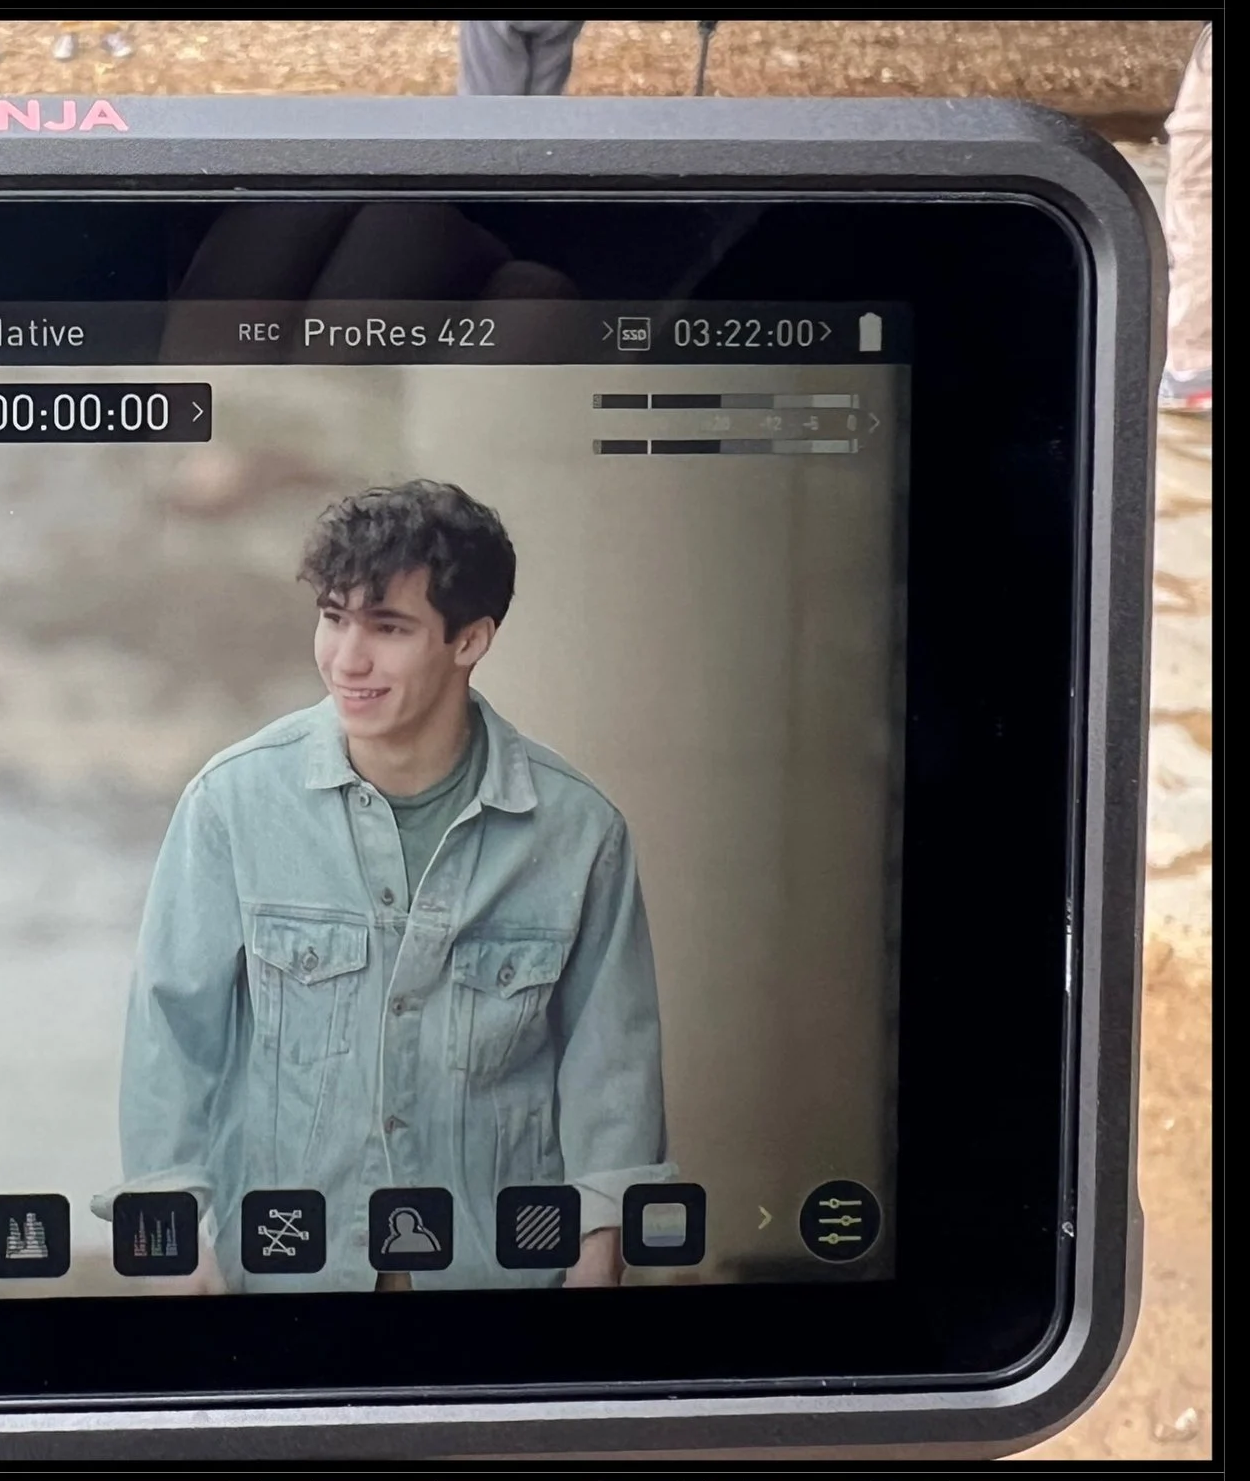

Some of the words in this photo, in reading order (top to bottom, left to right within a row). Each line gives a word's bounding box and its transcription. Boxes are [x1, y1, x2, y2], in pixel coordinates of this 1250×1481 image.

[238, 324, 280, 341] REC
[303, 319, 427, 347] ProRes
[438, 319, 495, 347] 422
[674, 319, 814, 347] 03:22:00
